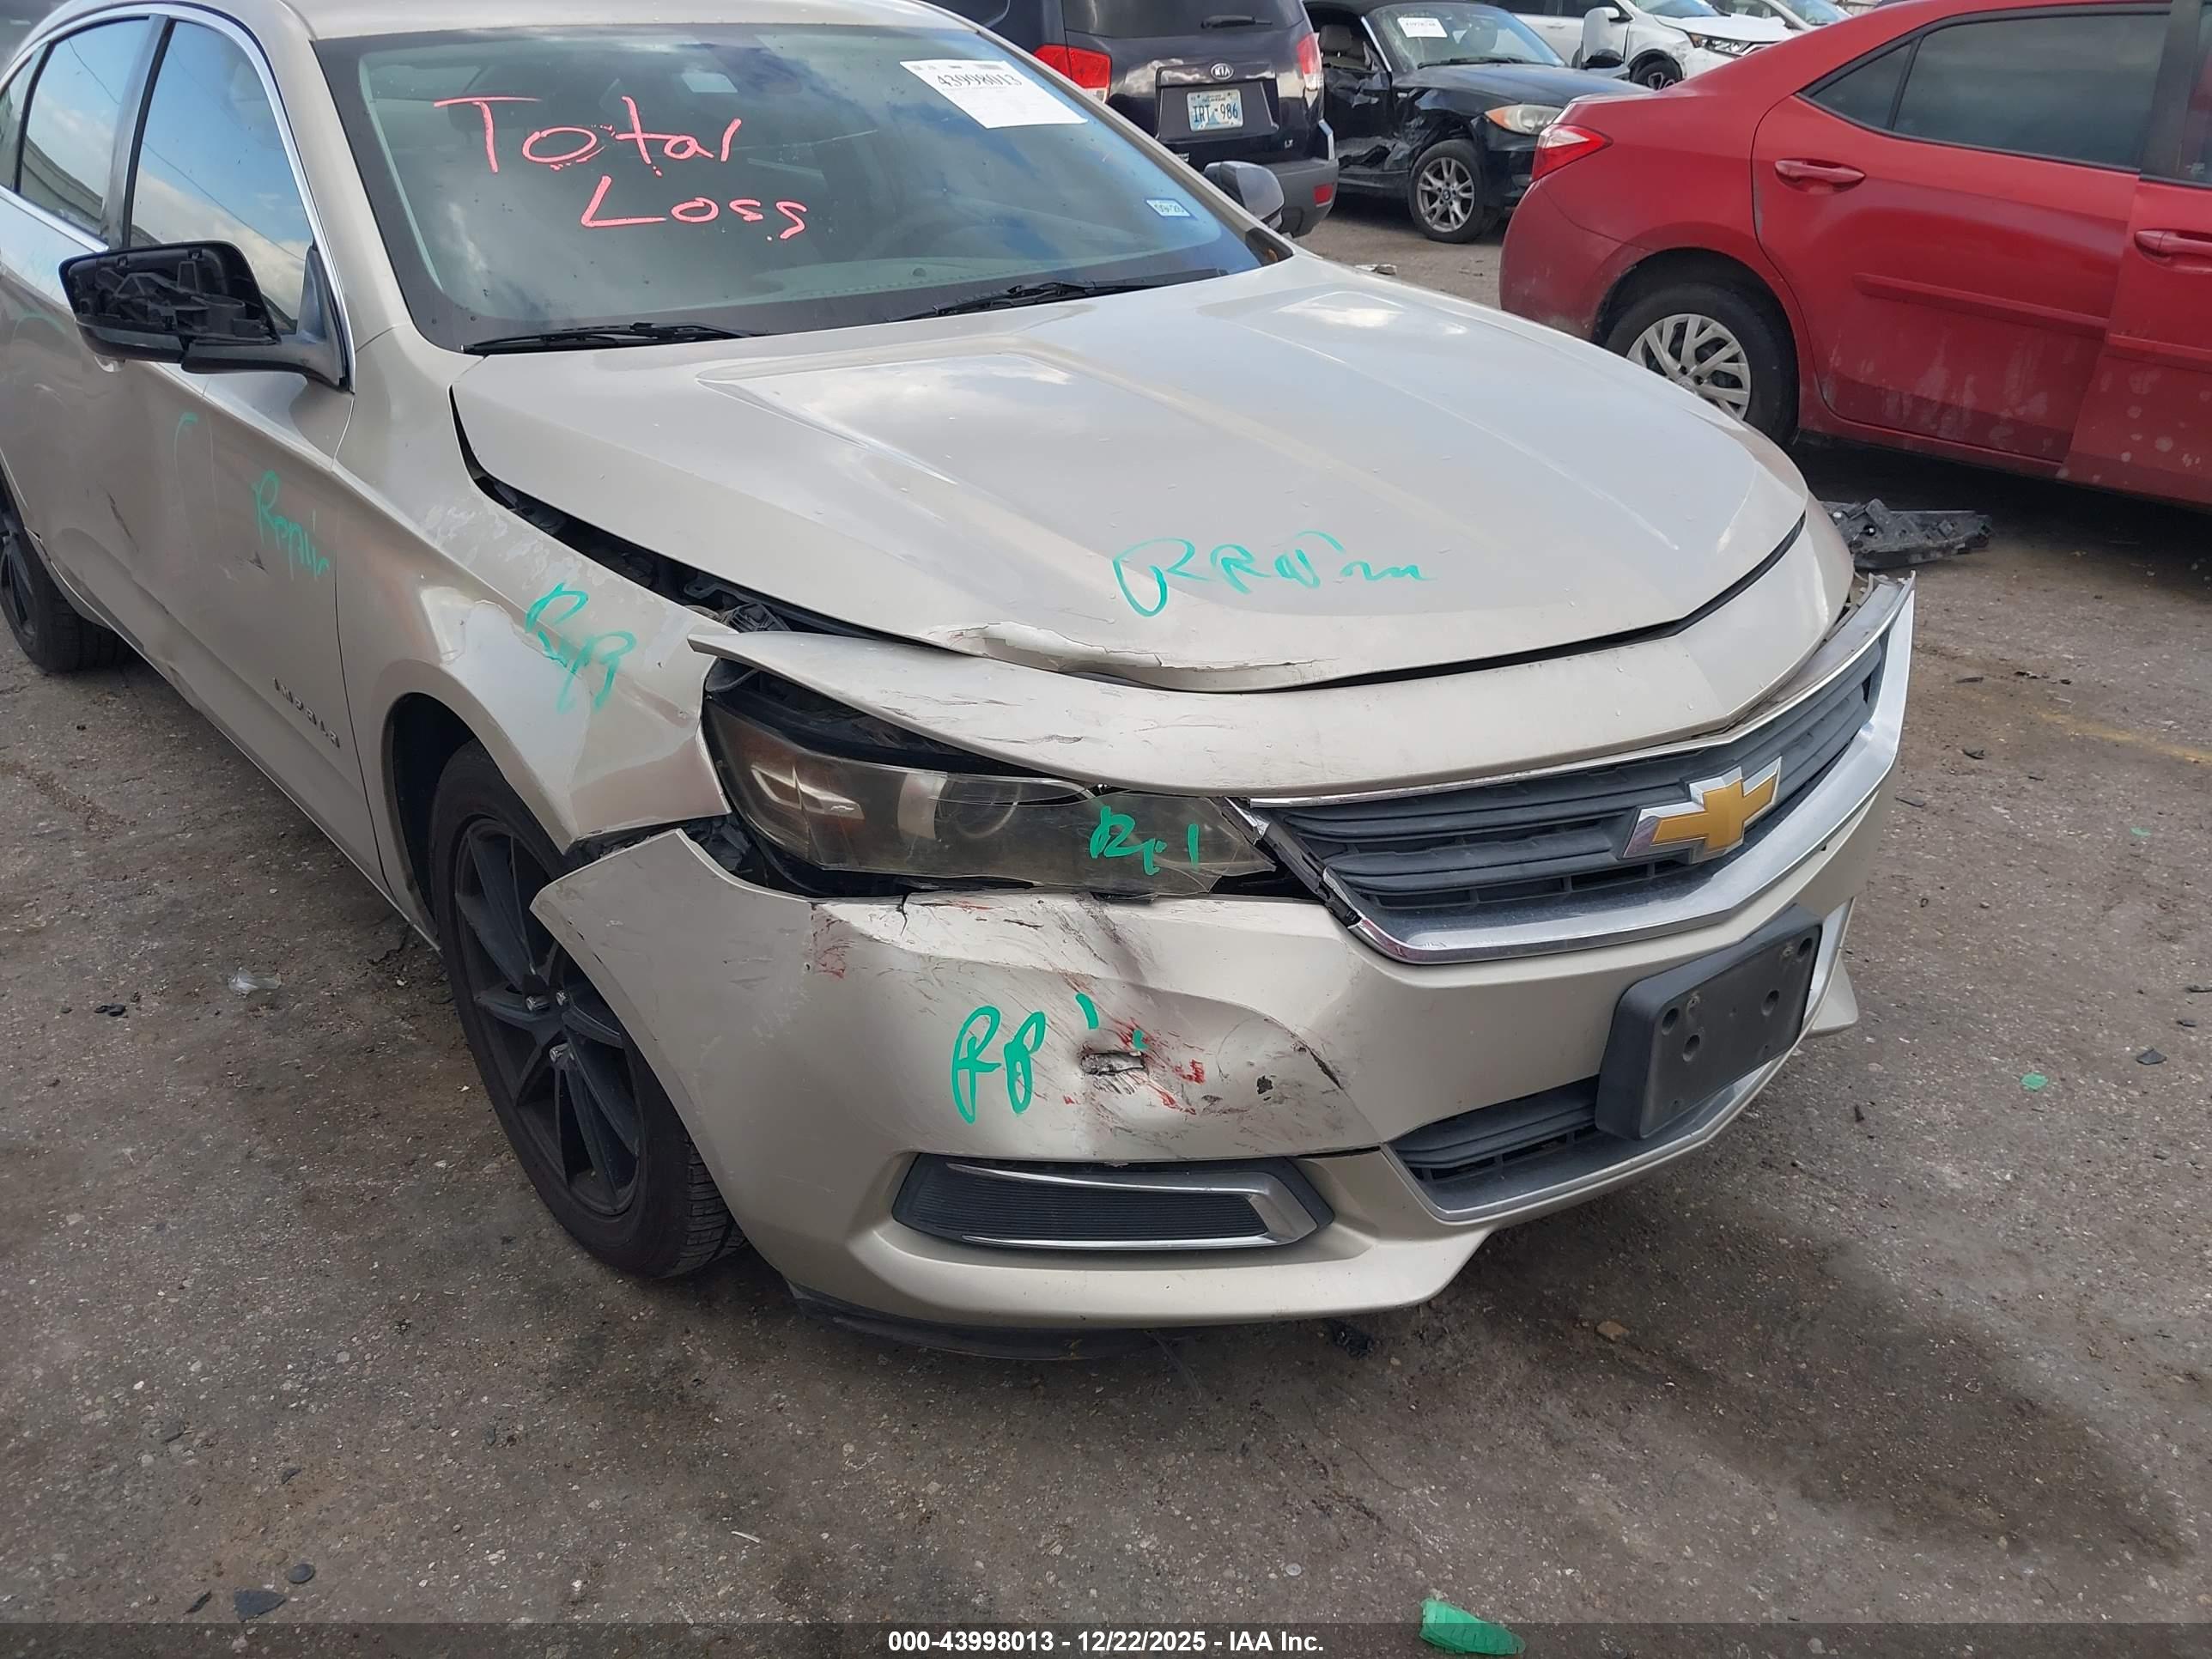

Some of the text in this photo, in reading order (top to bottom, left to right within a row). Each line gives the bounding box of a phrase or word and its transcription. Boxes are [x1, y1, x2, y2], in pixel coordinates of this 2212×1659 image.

[936, 72, 1024, 88] 43998013
[433, 95, 743, 176] Total
[580, 175, 808, 240] Loss
[273, 677, 341, 749] IMPALA
